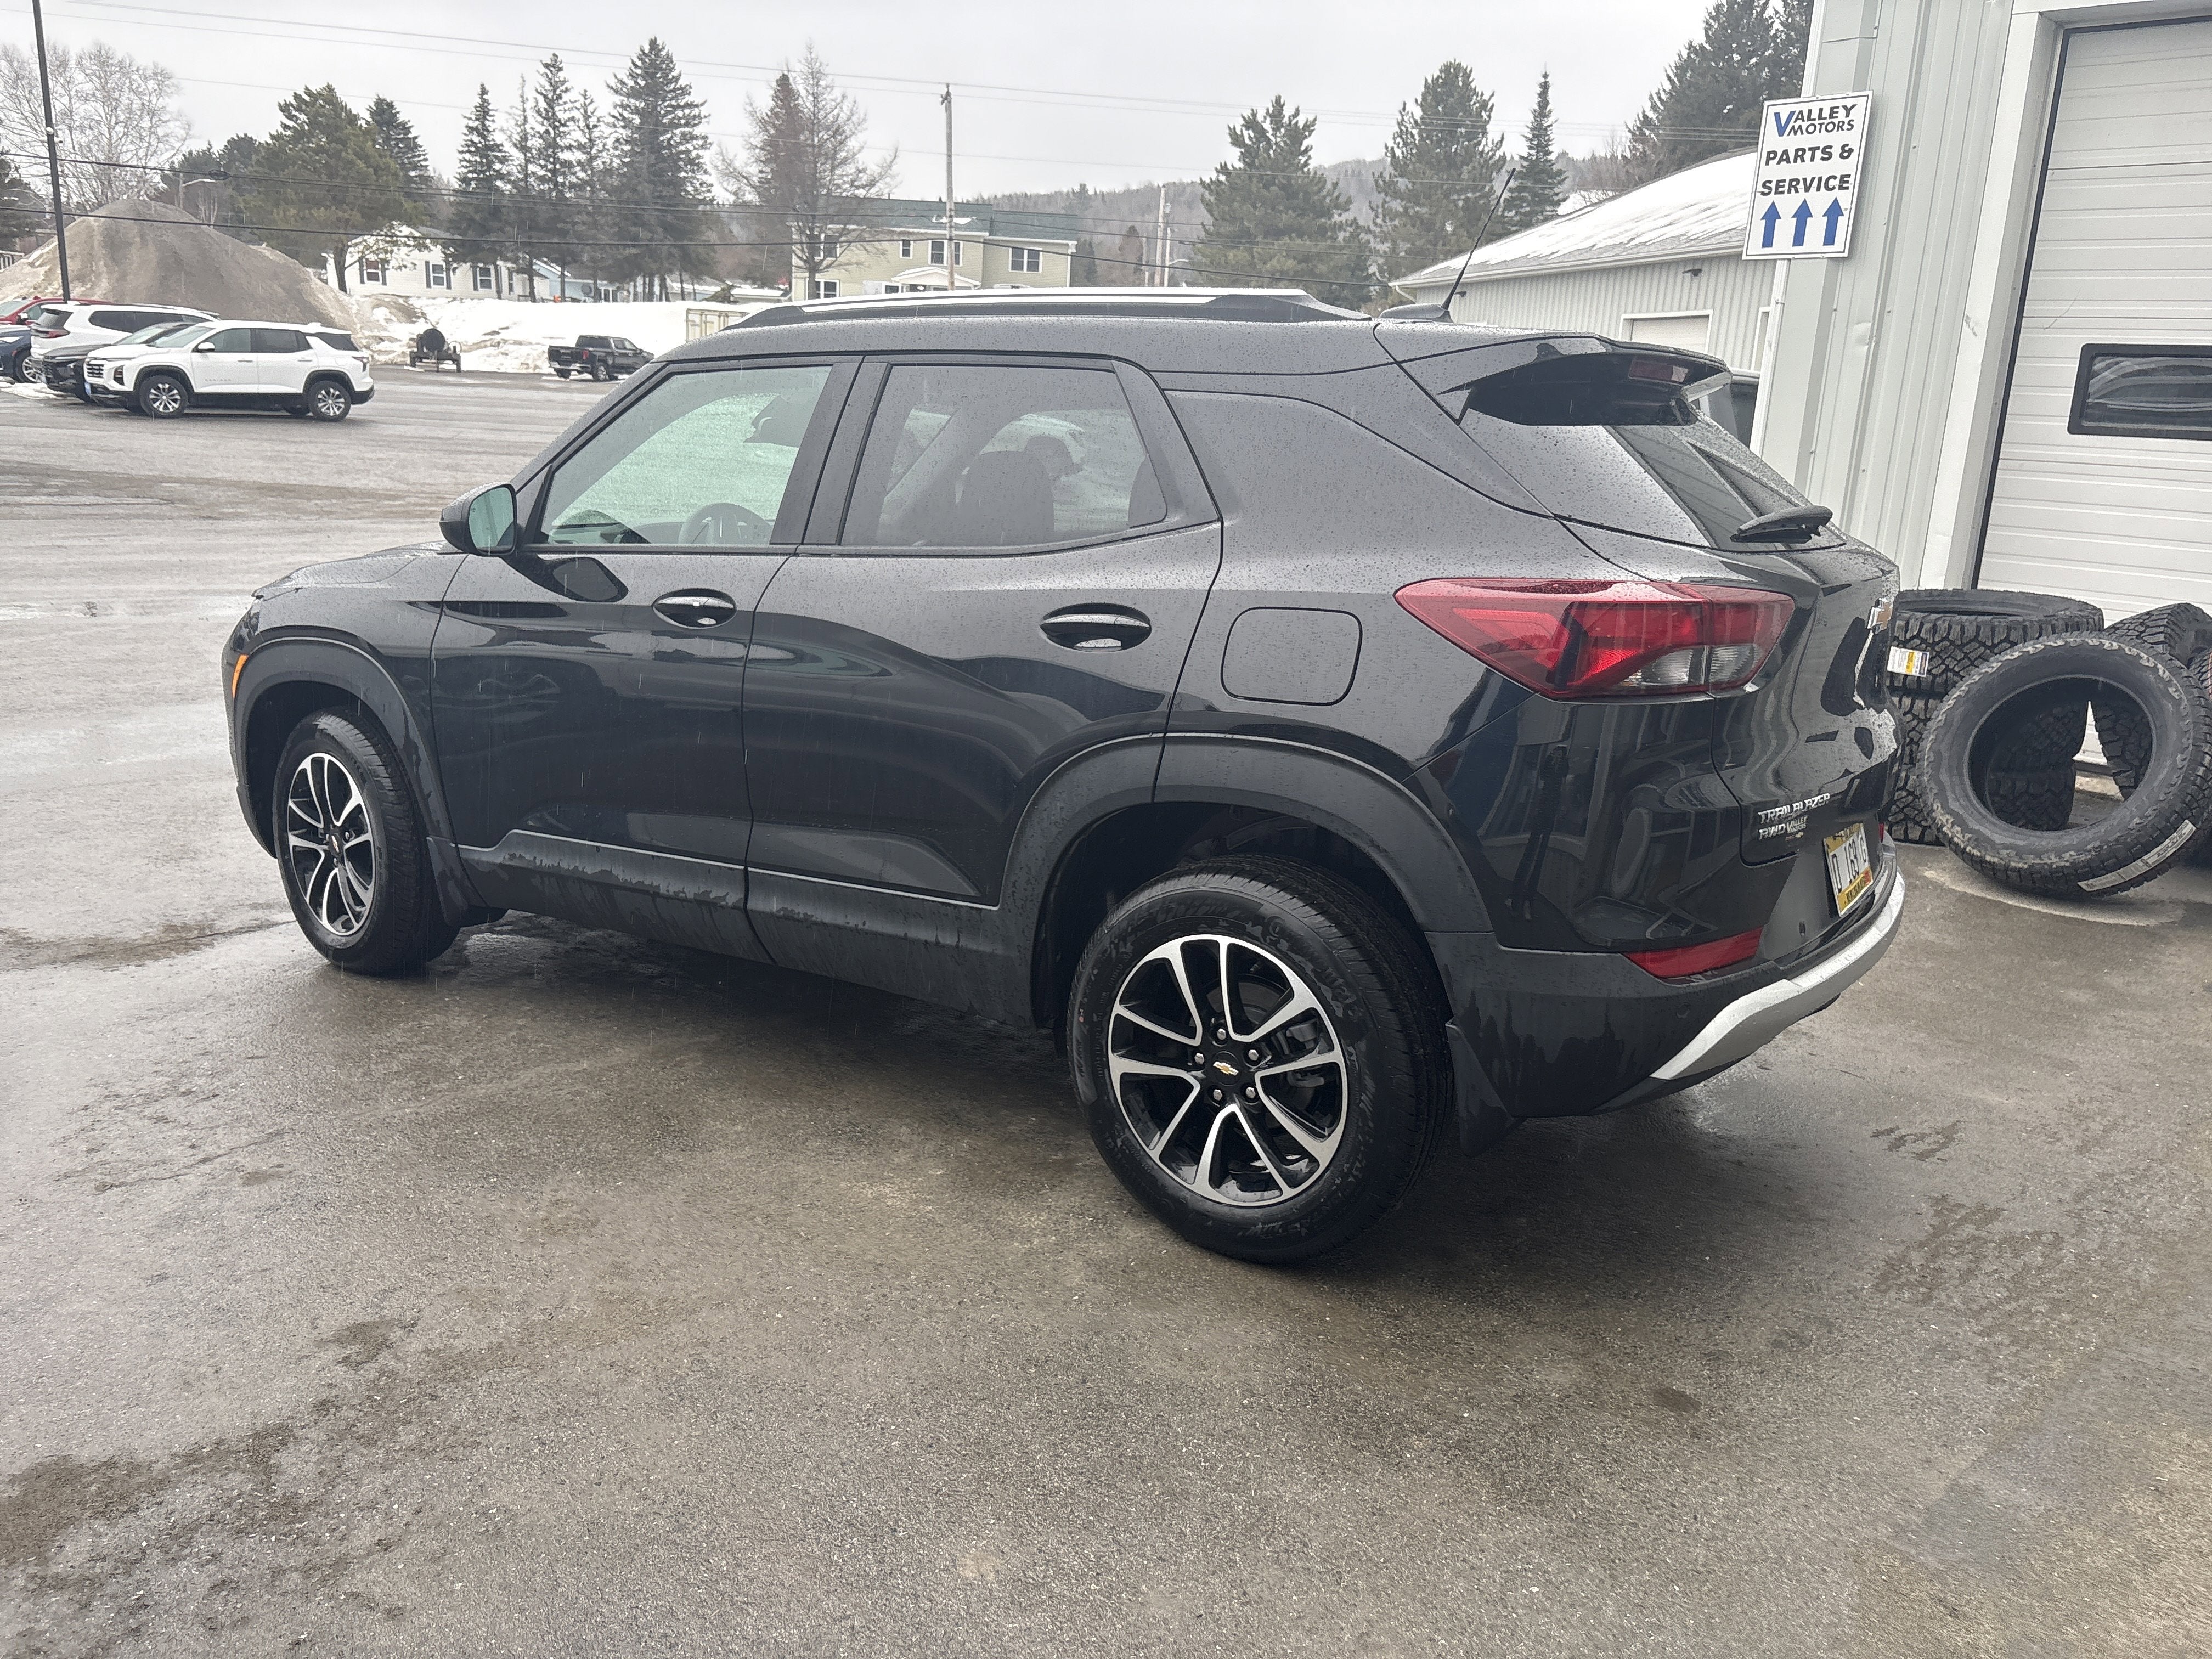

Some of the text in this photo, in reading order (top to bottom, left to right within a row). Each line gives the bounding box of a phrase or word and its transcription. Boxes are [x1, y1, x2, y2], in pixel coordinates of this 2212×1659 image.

[1774, 104, 1858, 137] VALLEY
[1786, 119, 1854, 137] MOTORS
[1764, 143, 1854, 166] PARTS &
[1760, 173, 1852, 196] SERVICE
